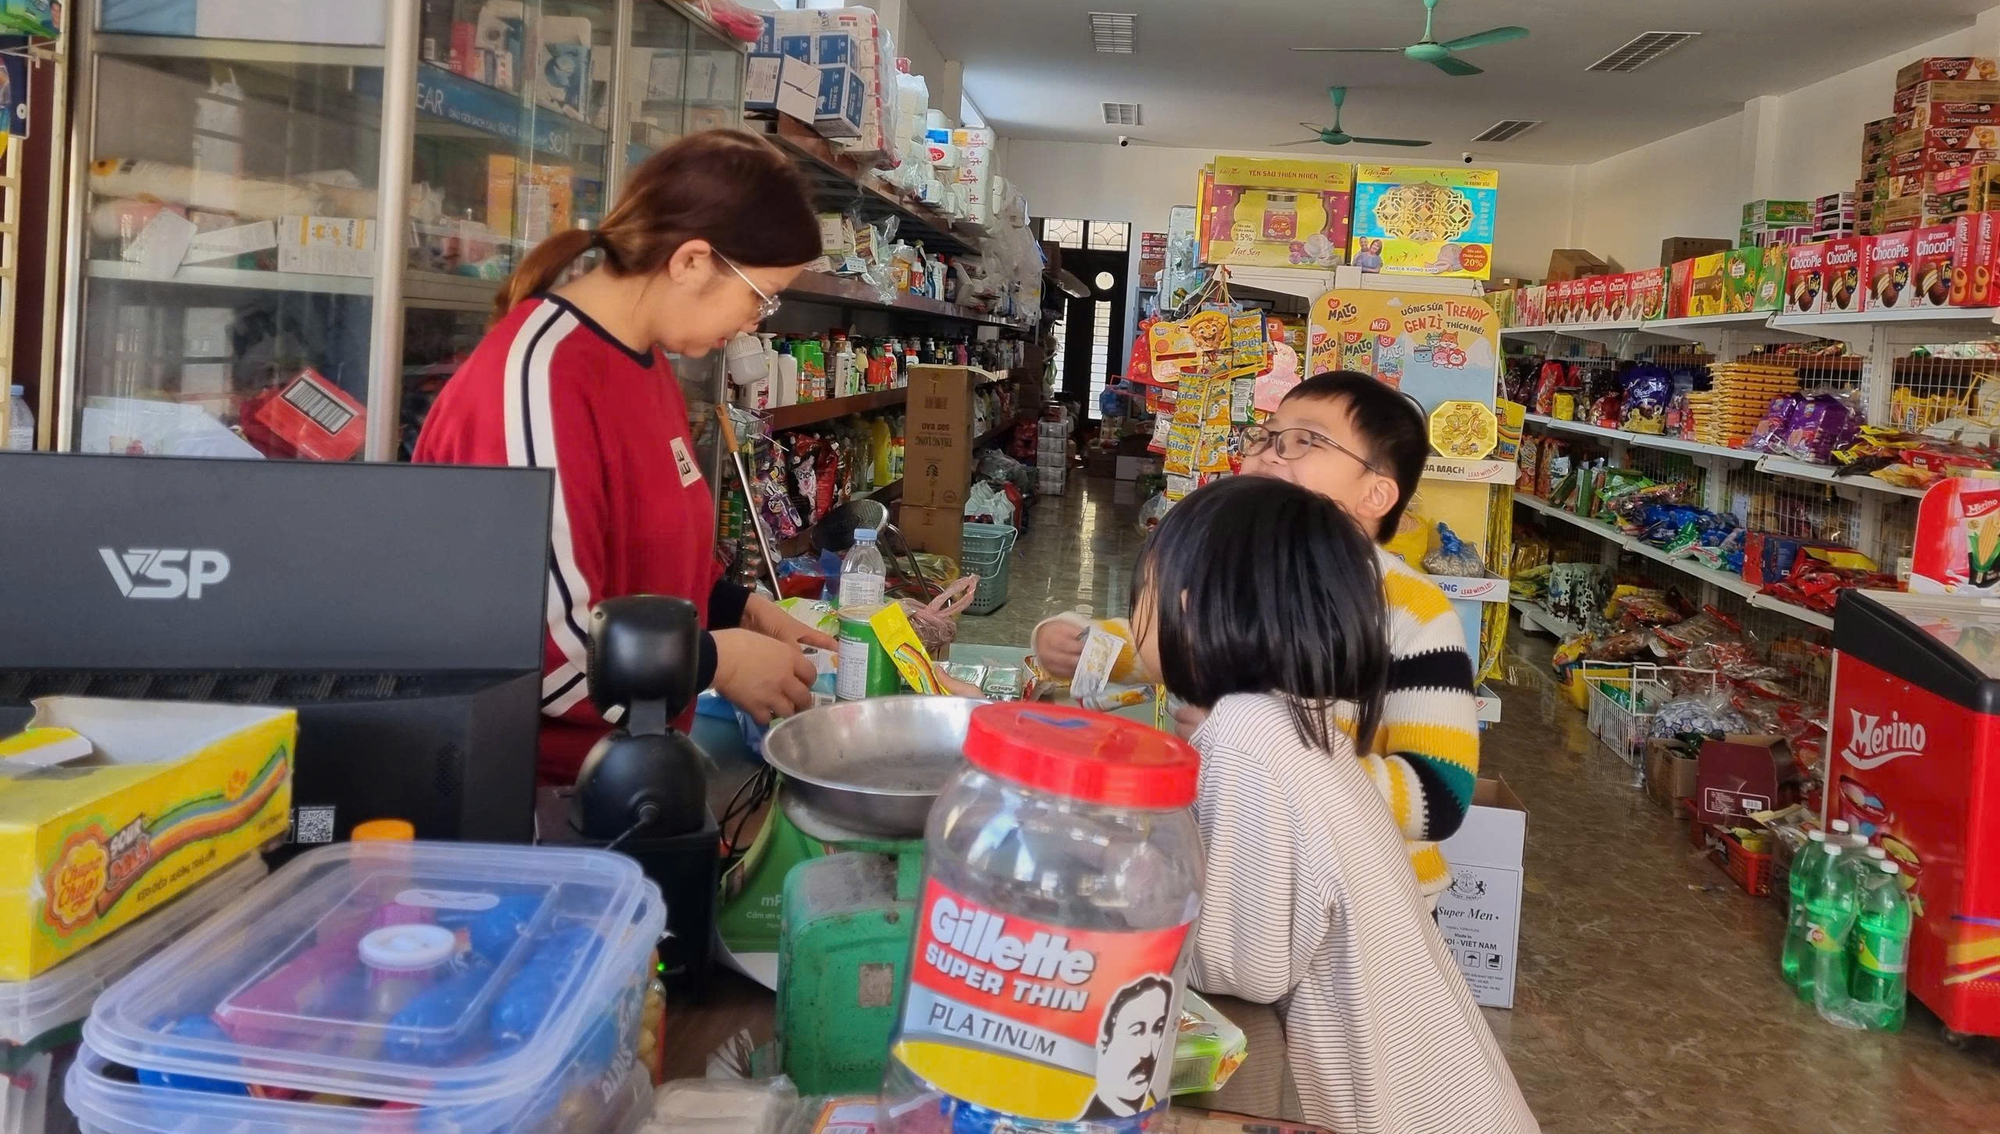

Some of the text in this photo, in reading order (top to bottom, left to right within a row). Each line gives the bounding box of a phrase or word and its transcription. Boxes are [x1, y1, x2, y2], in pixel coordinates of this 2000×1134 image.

[1931, 60, 1969, 69] KOKOMI
[1932, 128, 1970, 137] KOKOMI
[1935, 152, 1971, 161] KOKOMI
[1872, 244, 1909, 261] ChocoPie
[1916, 237, 1955, 256] ChocoPi
[1464, 258, 1483, 267] 20%
[1790, 255, 1821, 270] ChocoPie
[1827, 249, 1857, 265] ChocoPie
[1328, 303, 1357, 321] MALTO
[1401, 301, 1490, 322] UỐNG SỮA TRENDY
[1372, 319, 1389, 331] MỚI
[1404, 317, 1427, 334] GEN
[1428, 314, 1442, 330] ZÌ
[1446, 320, 1469, 331] THÍCH
[1312, 338, 1336, 356] MALTO
[1345, 338, 1372, 356] MALTO
[1437, 465, 1465, 475] MẠCH
[1967, 499, 1998, 514] Merino
[98, 549, 231, 599] VSP
[1848, 707, 1926, 756] Merino
[1438, 906, 1494, 921] Super Men
[930, 897, 1095, 985] Gillette
[1460, 939, 1477, 948] VIET
[1478, 942, 1497, 951] NAM
[925, 943, 1089, 1012] SUPER THIN
[927, 1003, 1057, 1057] PLATINUM
